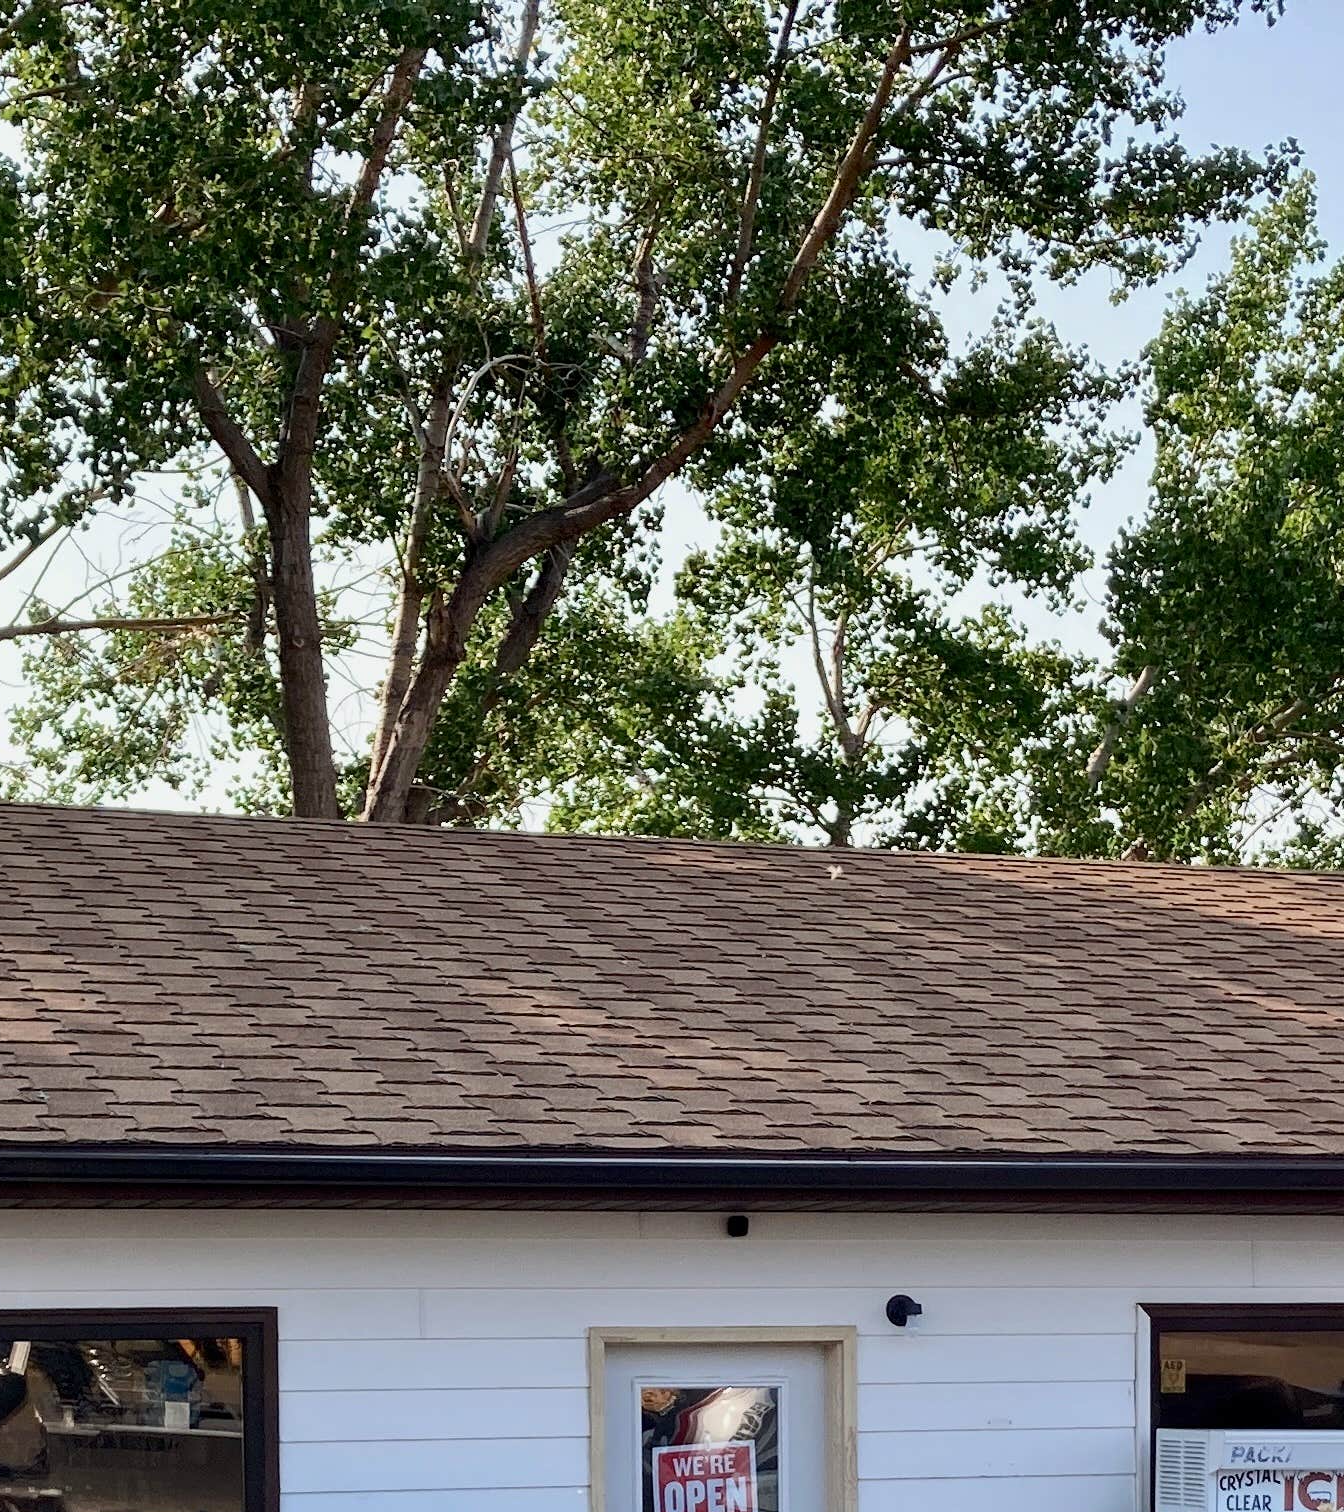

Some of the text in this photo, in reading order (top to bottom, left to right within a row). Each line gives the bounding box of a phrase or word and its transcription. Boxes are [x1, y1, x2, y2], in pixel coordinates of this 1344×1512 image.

[672, 1453, 737, 1477] WE'RE
[1219, 1469, 1281, 1491] CRYSTAL
[1226, 1495, 1272, 1512] CLEAR
